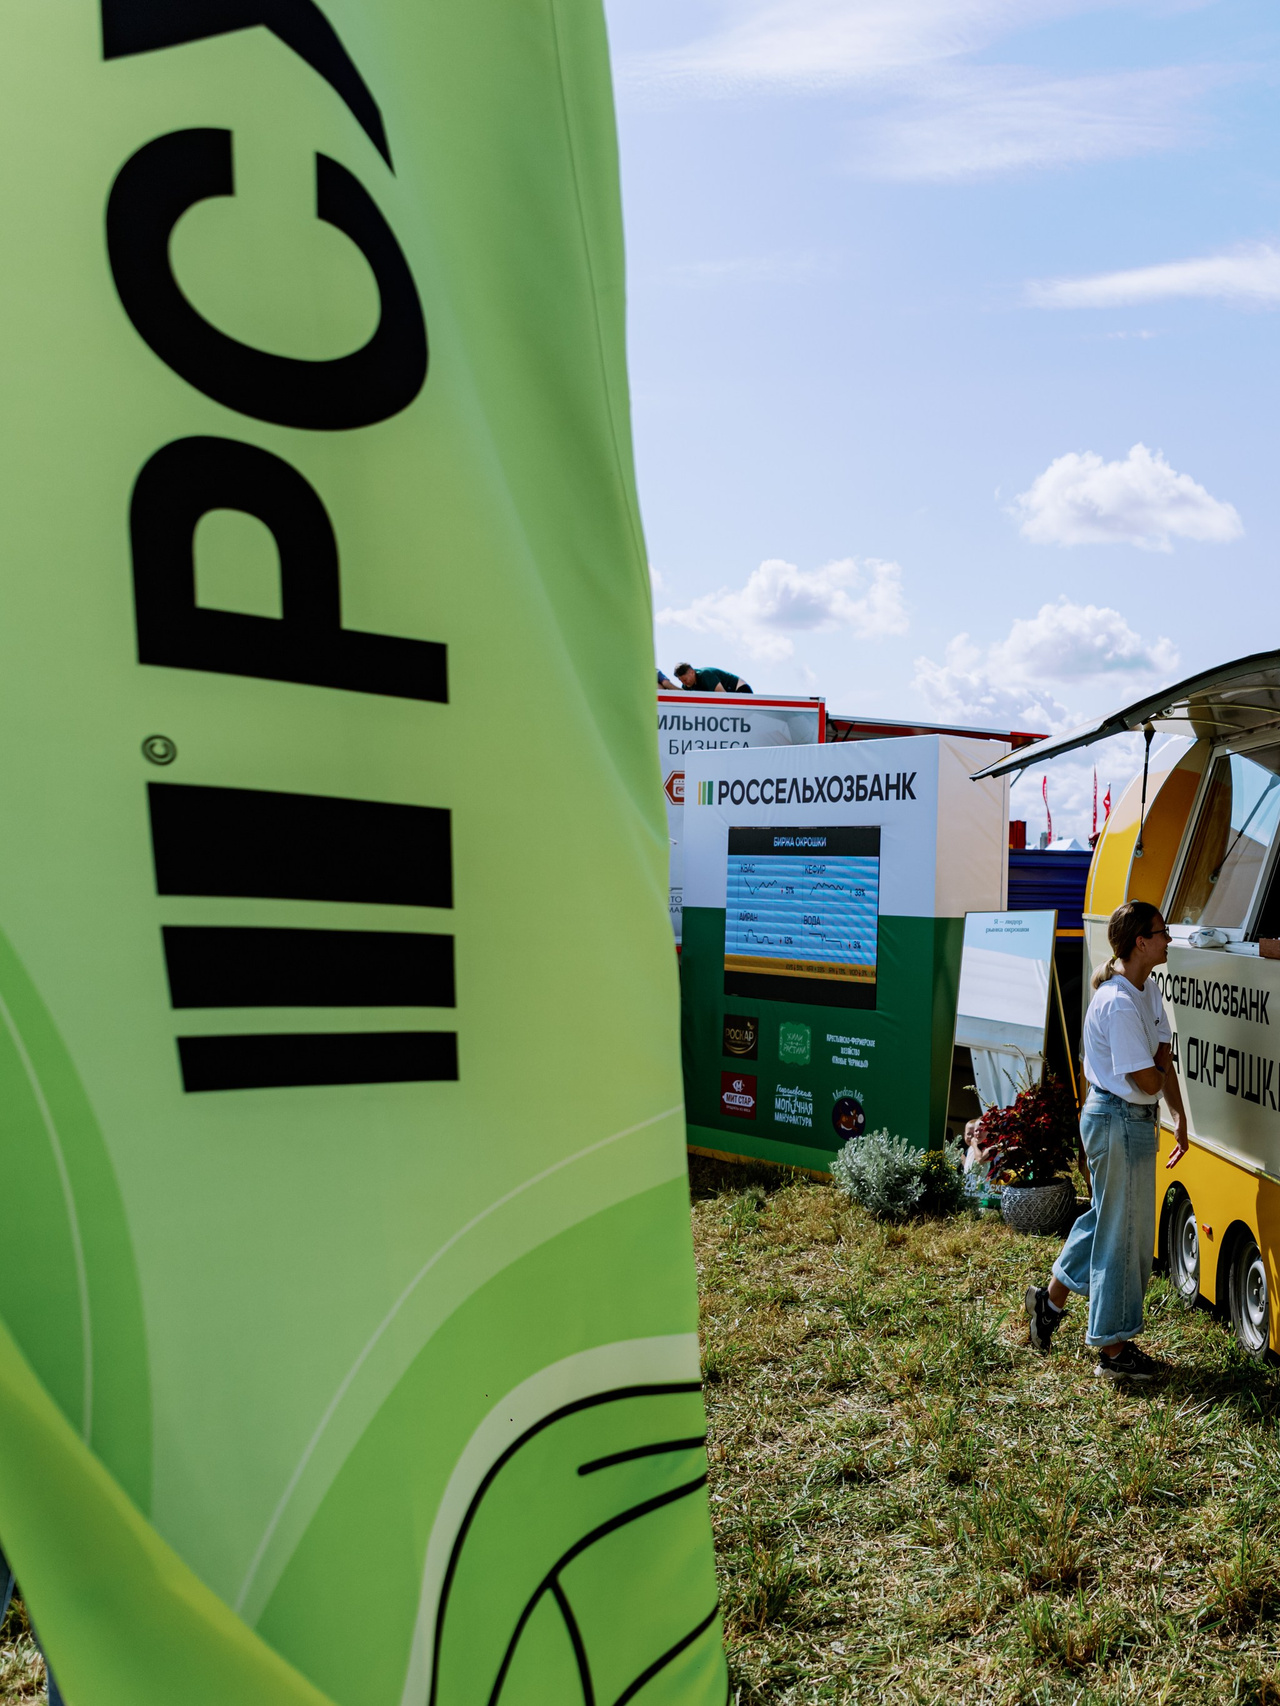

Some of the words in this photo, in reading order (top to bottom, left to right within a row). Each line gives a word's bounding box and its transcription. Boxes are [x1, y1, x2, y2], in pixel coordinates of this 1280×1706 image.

[717, 771, 918, 806] РОССЕЛЬХОЗБАНК
[773, 836, 795, 847] БИРЖА
[795, 836, 827, 847] ОКРОШКИ
[804, 864, 827, 875] КЕФИР
[854, 888, 866, 897] 33%
[803, 915, 821, 927] ВОДА
[853, 940, 862, 949] 3%
[725, 1028, 755, 1042] РОСКАР
[774, 1111, 813, 1128] МАНУФАКТУРА
